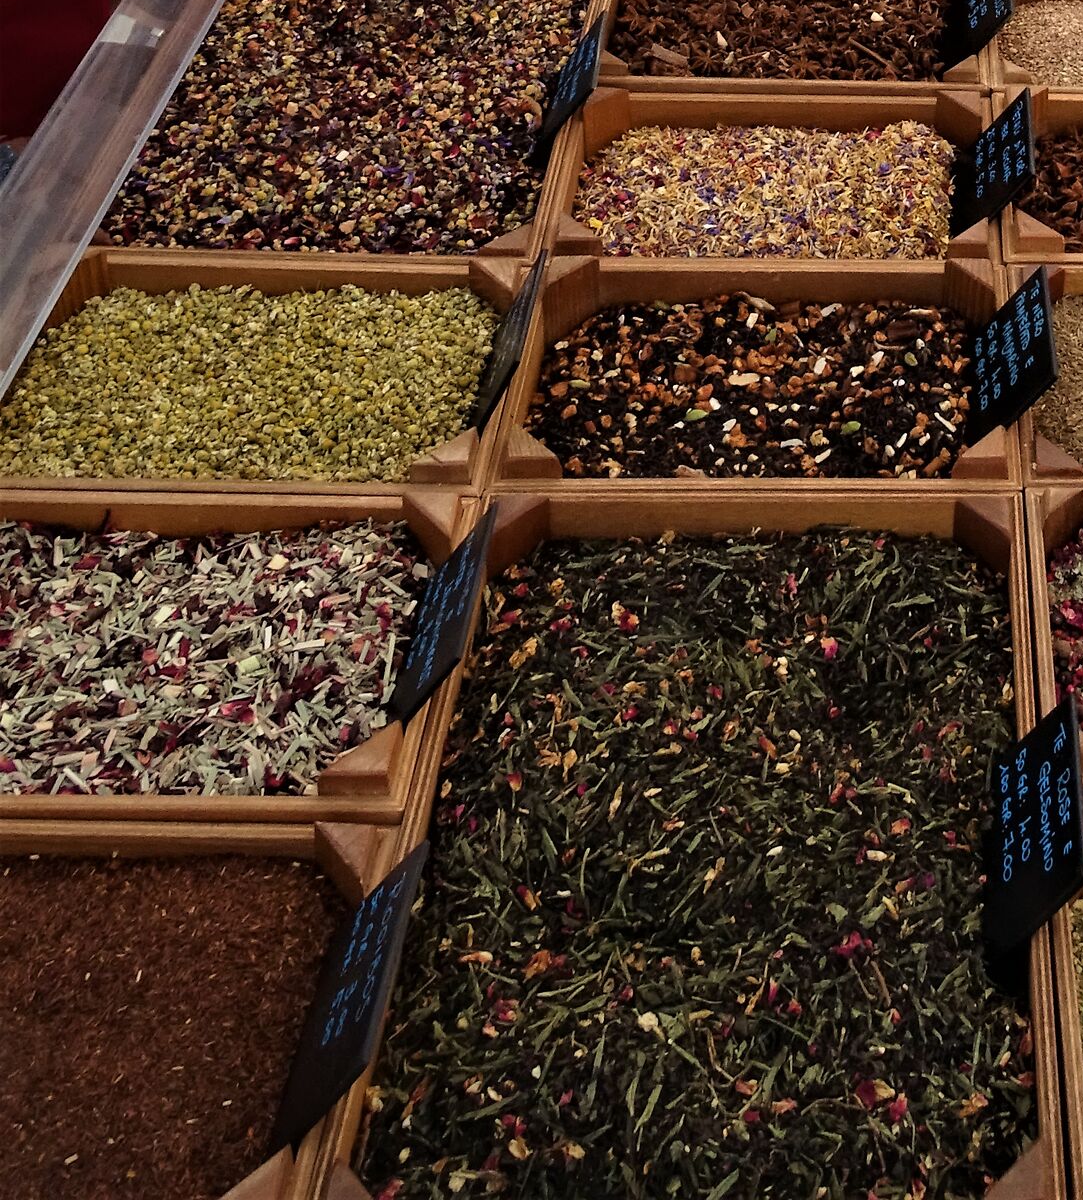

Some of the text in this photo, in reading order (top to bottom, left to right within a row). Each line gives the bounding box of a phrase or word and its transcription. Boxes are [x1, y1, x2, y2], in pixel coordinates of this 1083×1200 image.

[987, 321, 998, 339] 50
[1032, 303, 1044, 337] NERO
[999, 765, 1014, 882] 100 GR: 7.00
[1015, 748, 1031, 862] 50 GR: 4.00
[1037, 761, 1055, 871] GELSOMINO
[1054, 722, 1072, 855] TE ROSE E
